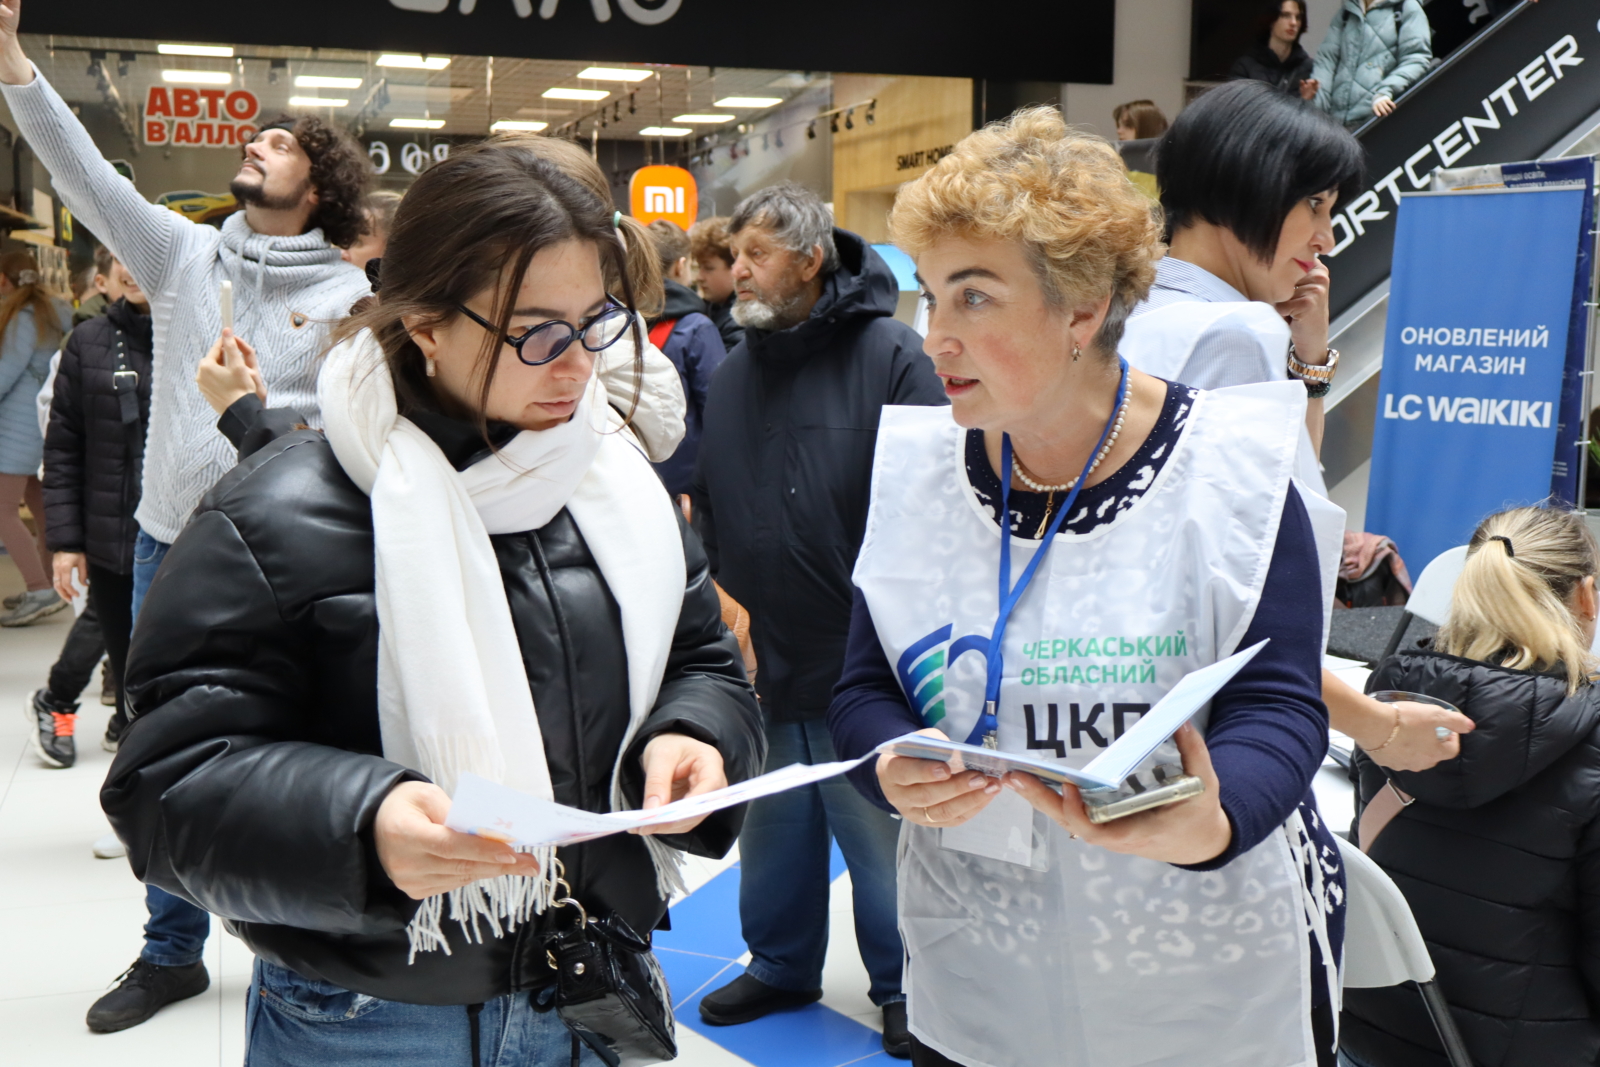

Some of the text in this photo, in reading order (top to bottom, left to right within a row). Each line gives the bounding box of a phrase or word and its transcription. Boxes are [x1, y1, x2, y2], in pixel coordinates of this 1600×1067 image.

[145, 85, 260, 121] АВТО
[145, 120, 167, 143] В
[896, 151, 924, 171] SMART
[1401, 325, 1549, 348] ОНОВЛЕНИЙ
[1414, 354, 1526, 375] МАГАЗИН
[1384, 393, 1423, 420] LC
[1022, 630, 1187, 660] ЧЕРКАСЬКИЙ
[1021, 659, 1156, 686] ОБЛАСНИЙ
